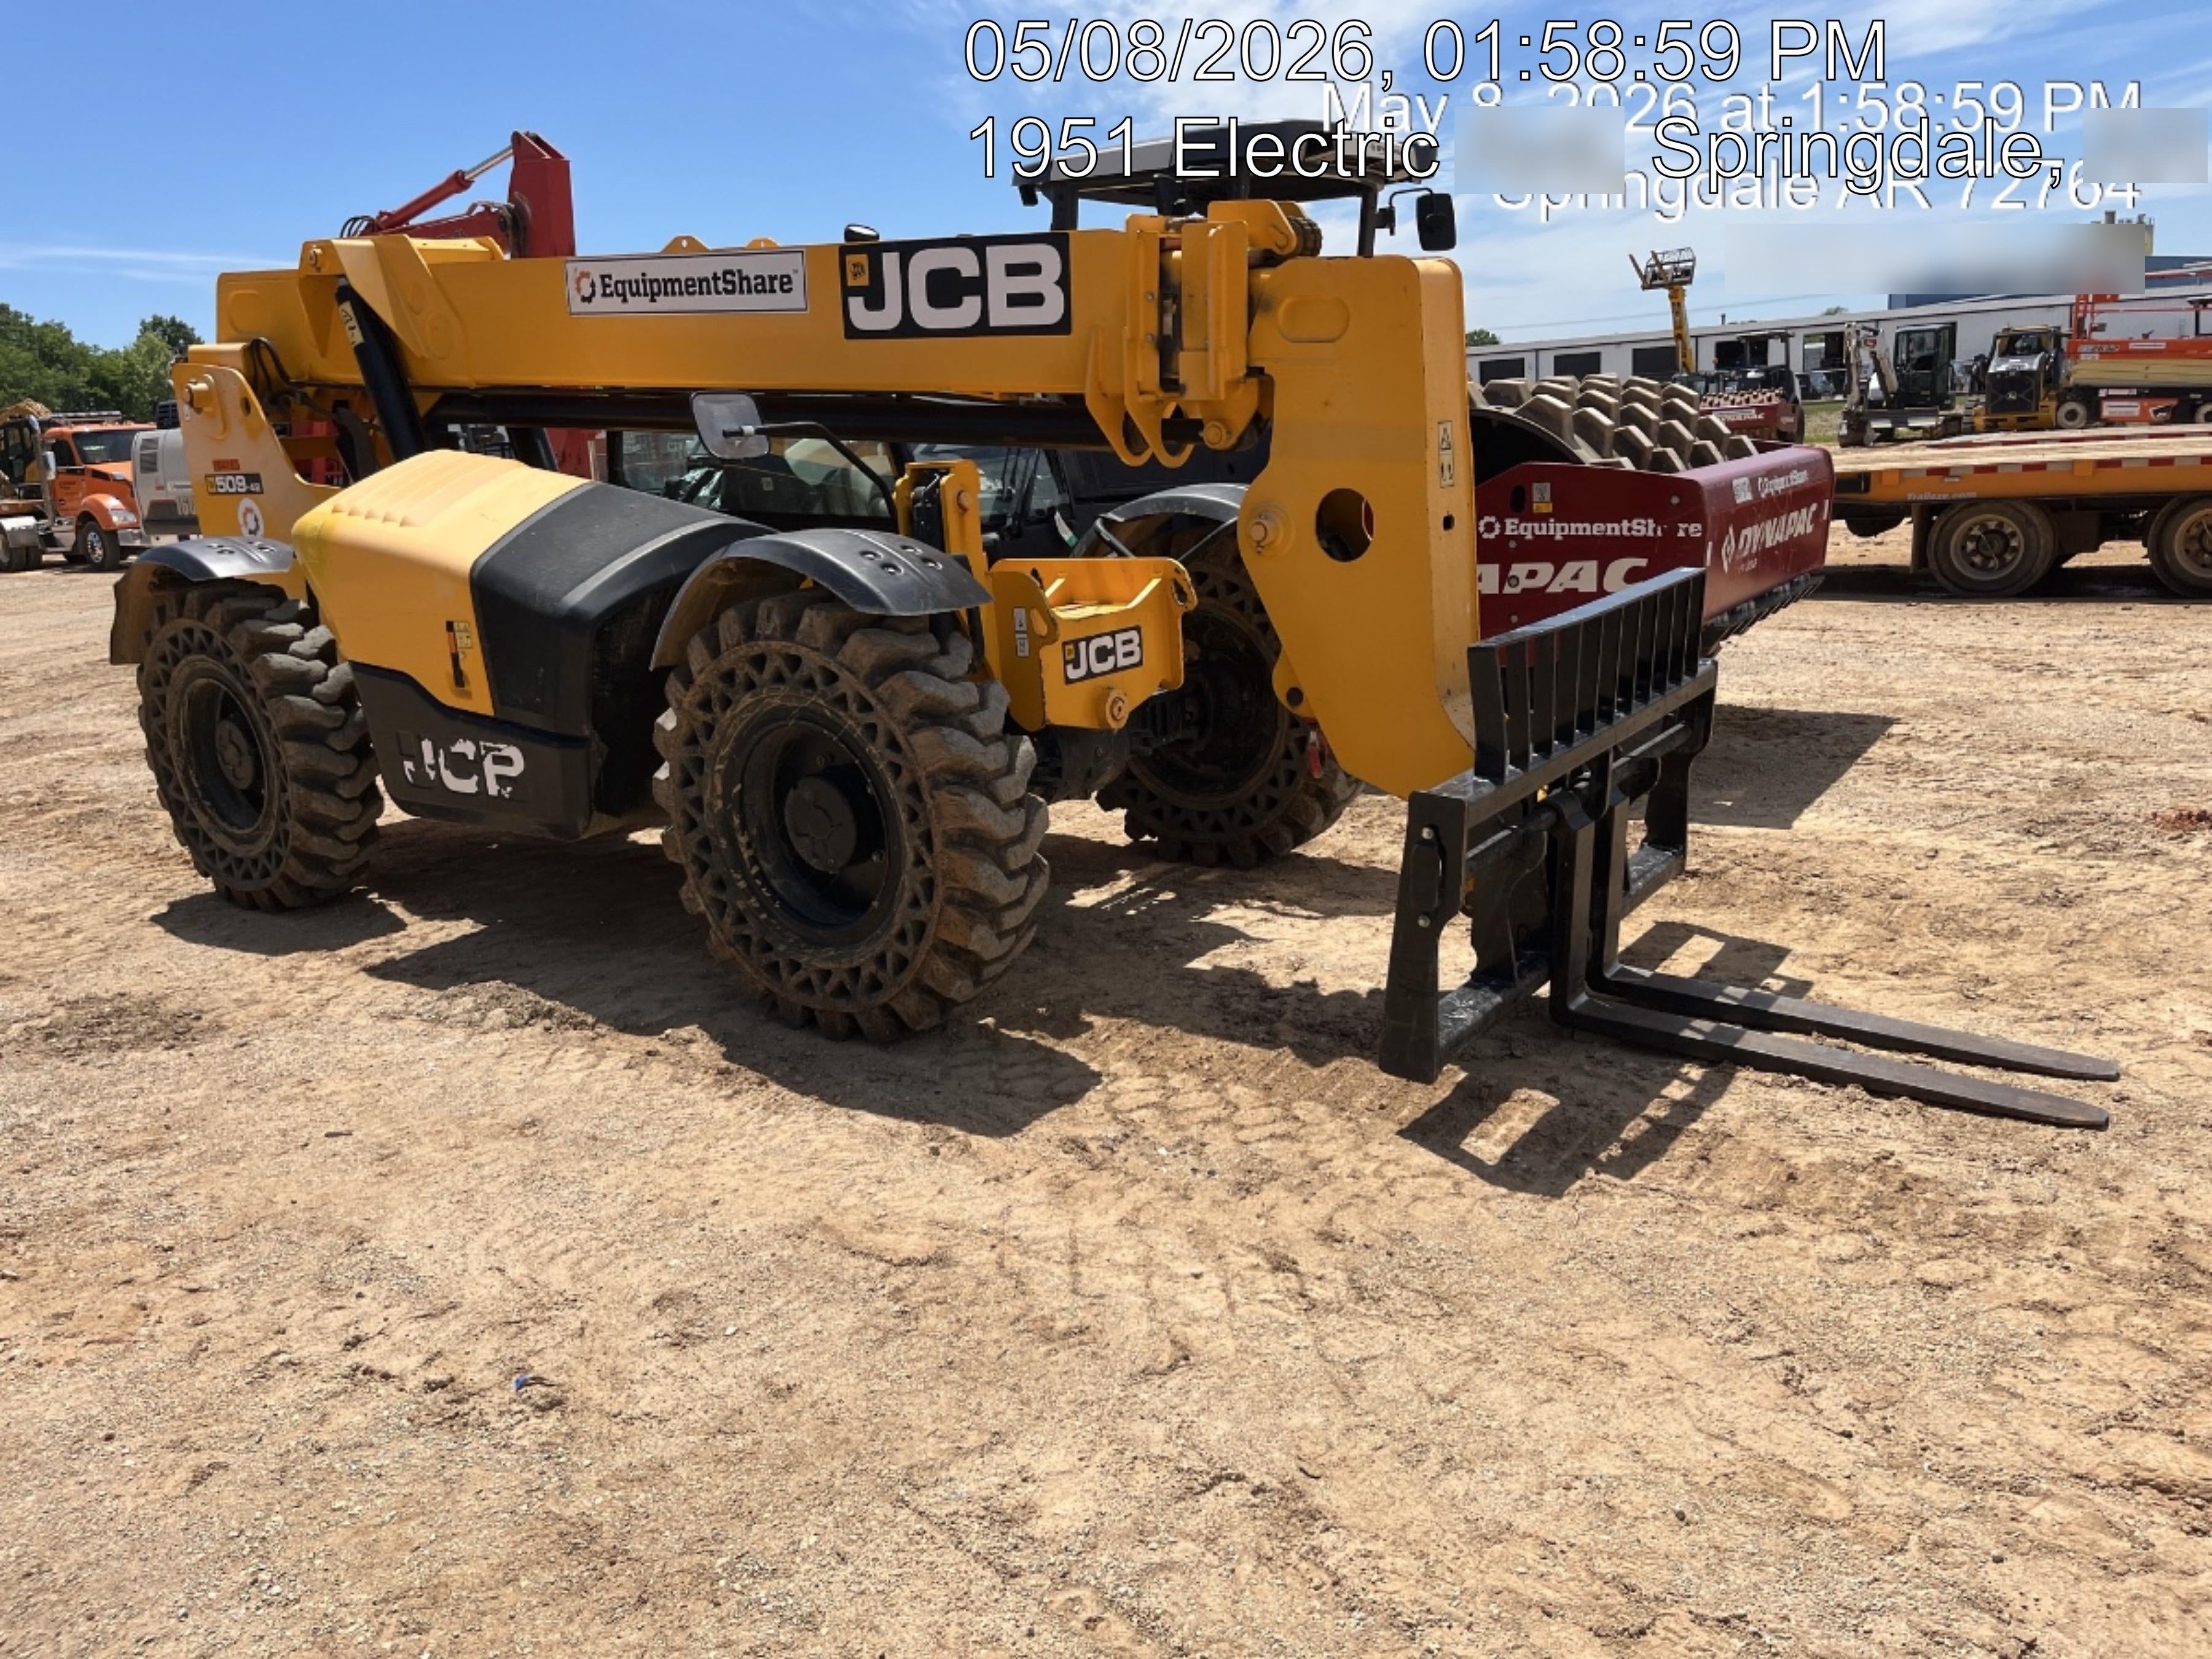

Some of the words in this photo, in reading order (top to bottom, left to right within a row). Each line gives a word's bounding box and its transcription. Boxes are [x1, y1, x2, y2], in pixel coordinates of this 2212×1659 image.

[600, 269, 795, 304] EquipmentShare
[848, 243, 1065, 331] JCB
[1504, 517, 1703, 541] EquipmentShre
[1066, 629, 1142, 680] JCB
